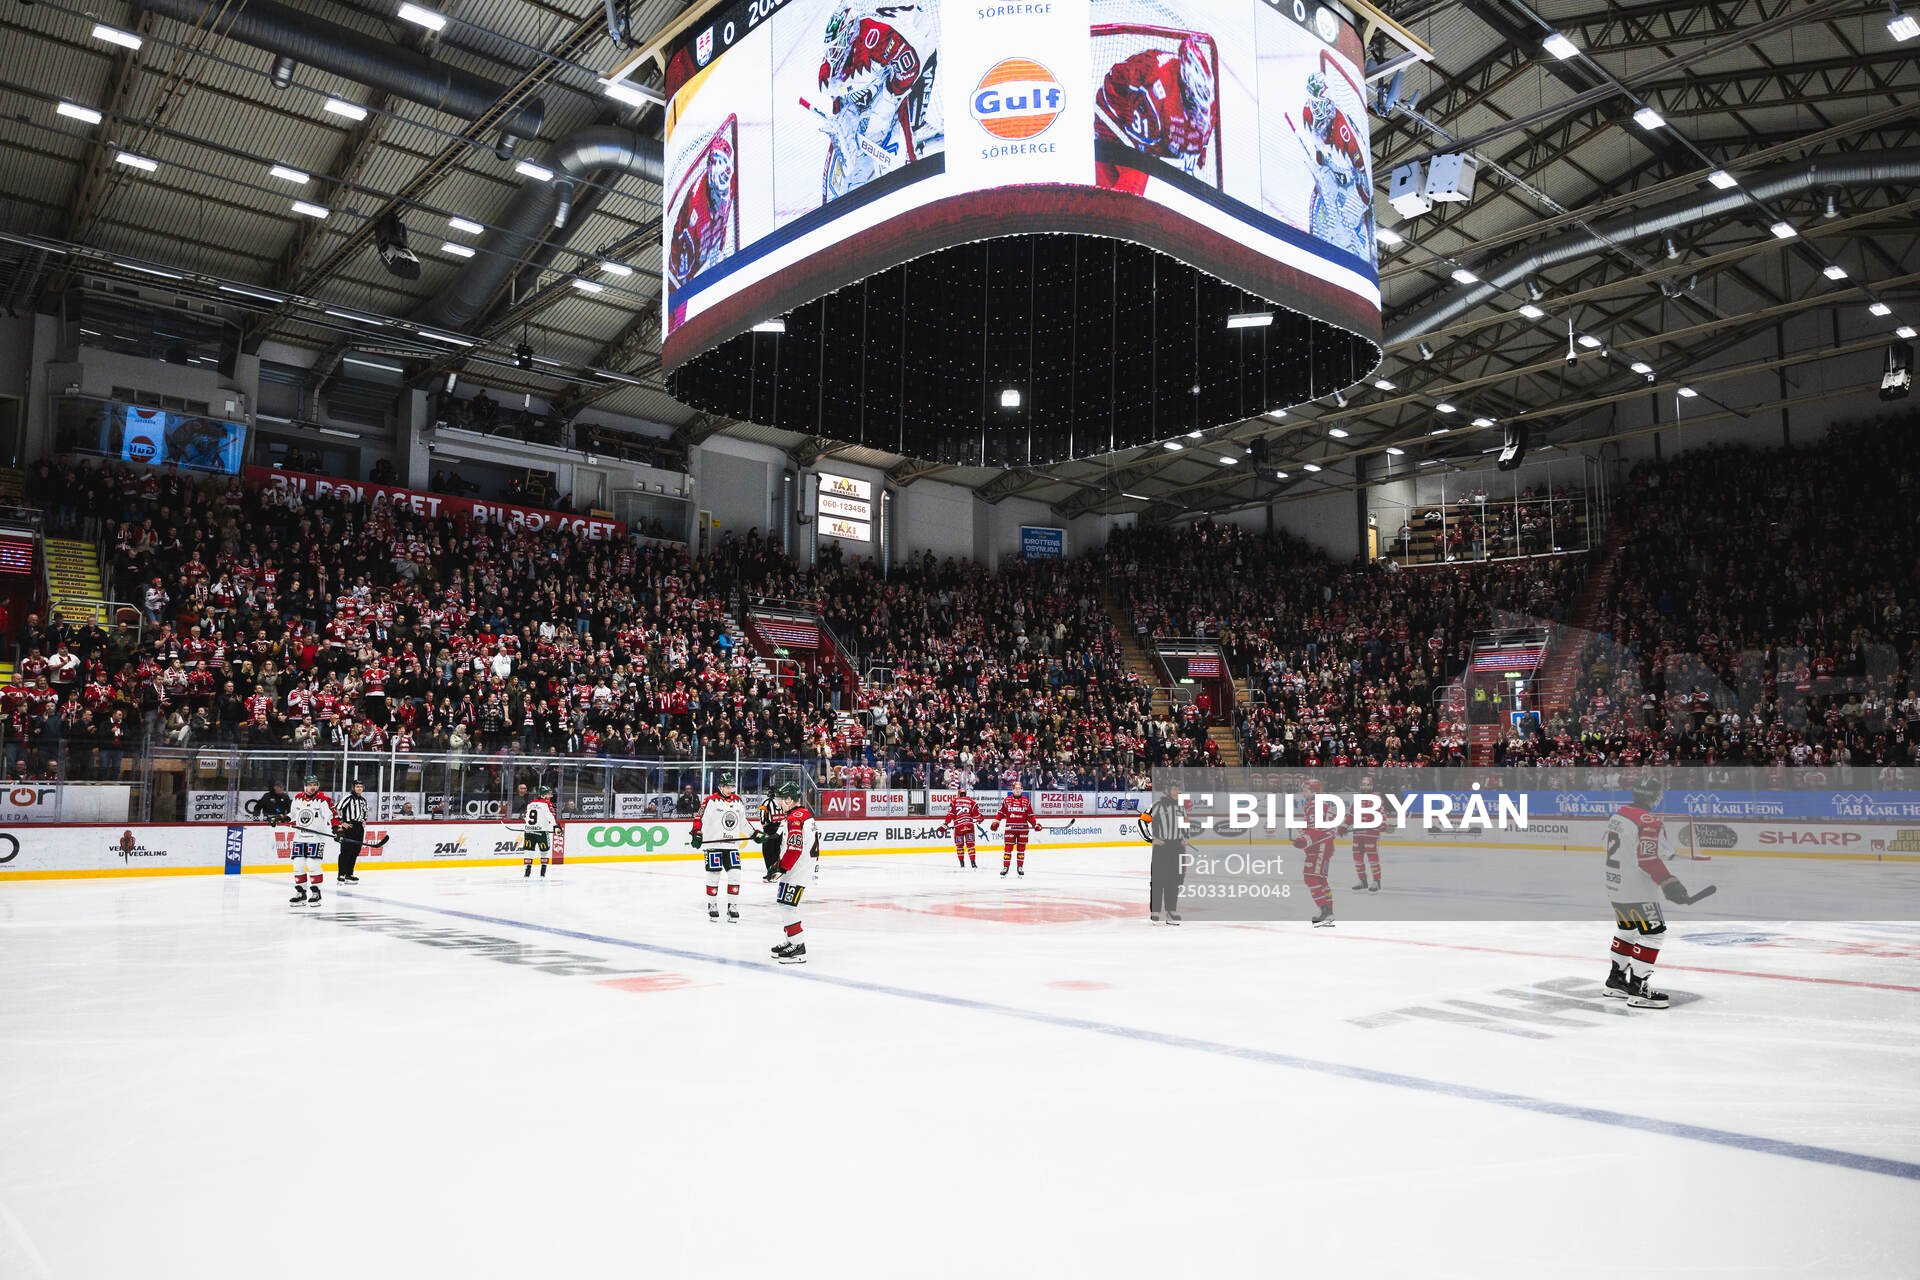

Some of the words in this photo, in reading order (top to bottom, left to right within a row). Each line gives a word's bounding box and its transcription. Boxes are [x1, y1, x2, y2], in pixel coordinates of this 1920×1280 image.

[978, 4, 1052, 19] SÖRBERGE
[724, 22, 735, 45] 0
[975, 88, 1061, 114] Gulf
[981, 142, 1056, 160] SÖRBERGE
[833, 480, 857, 493] TAXI
[822, 499, 866, 514] 060-123456
[832, 523, 857, 535] TAXI
[827, 797, 860, 812] AVIS
[870, 795, 904, 803] BUCHER
[1041, 793, 1084, 802] PIZZERIA
[528, 809, 538, 825] 9
[587, 825, 670, 852] coop
[1049, 826, 1102, 836] Handelsbanken
[1758, 830, 1862, 846] SHARP
[788, 834, 803, 846] 46
[1641, 840, 1656, 855] 12
